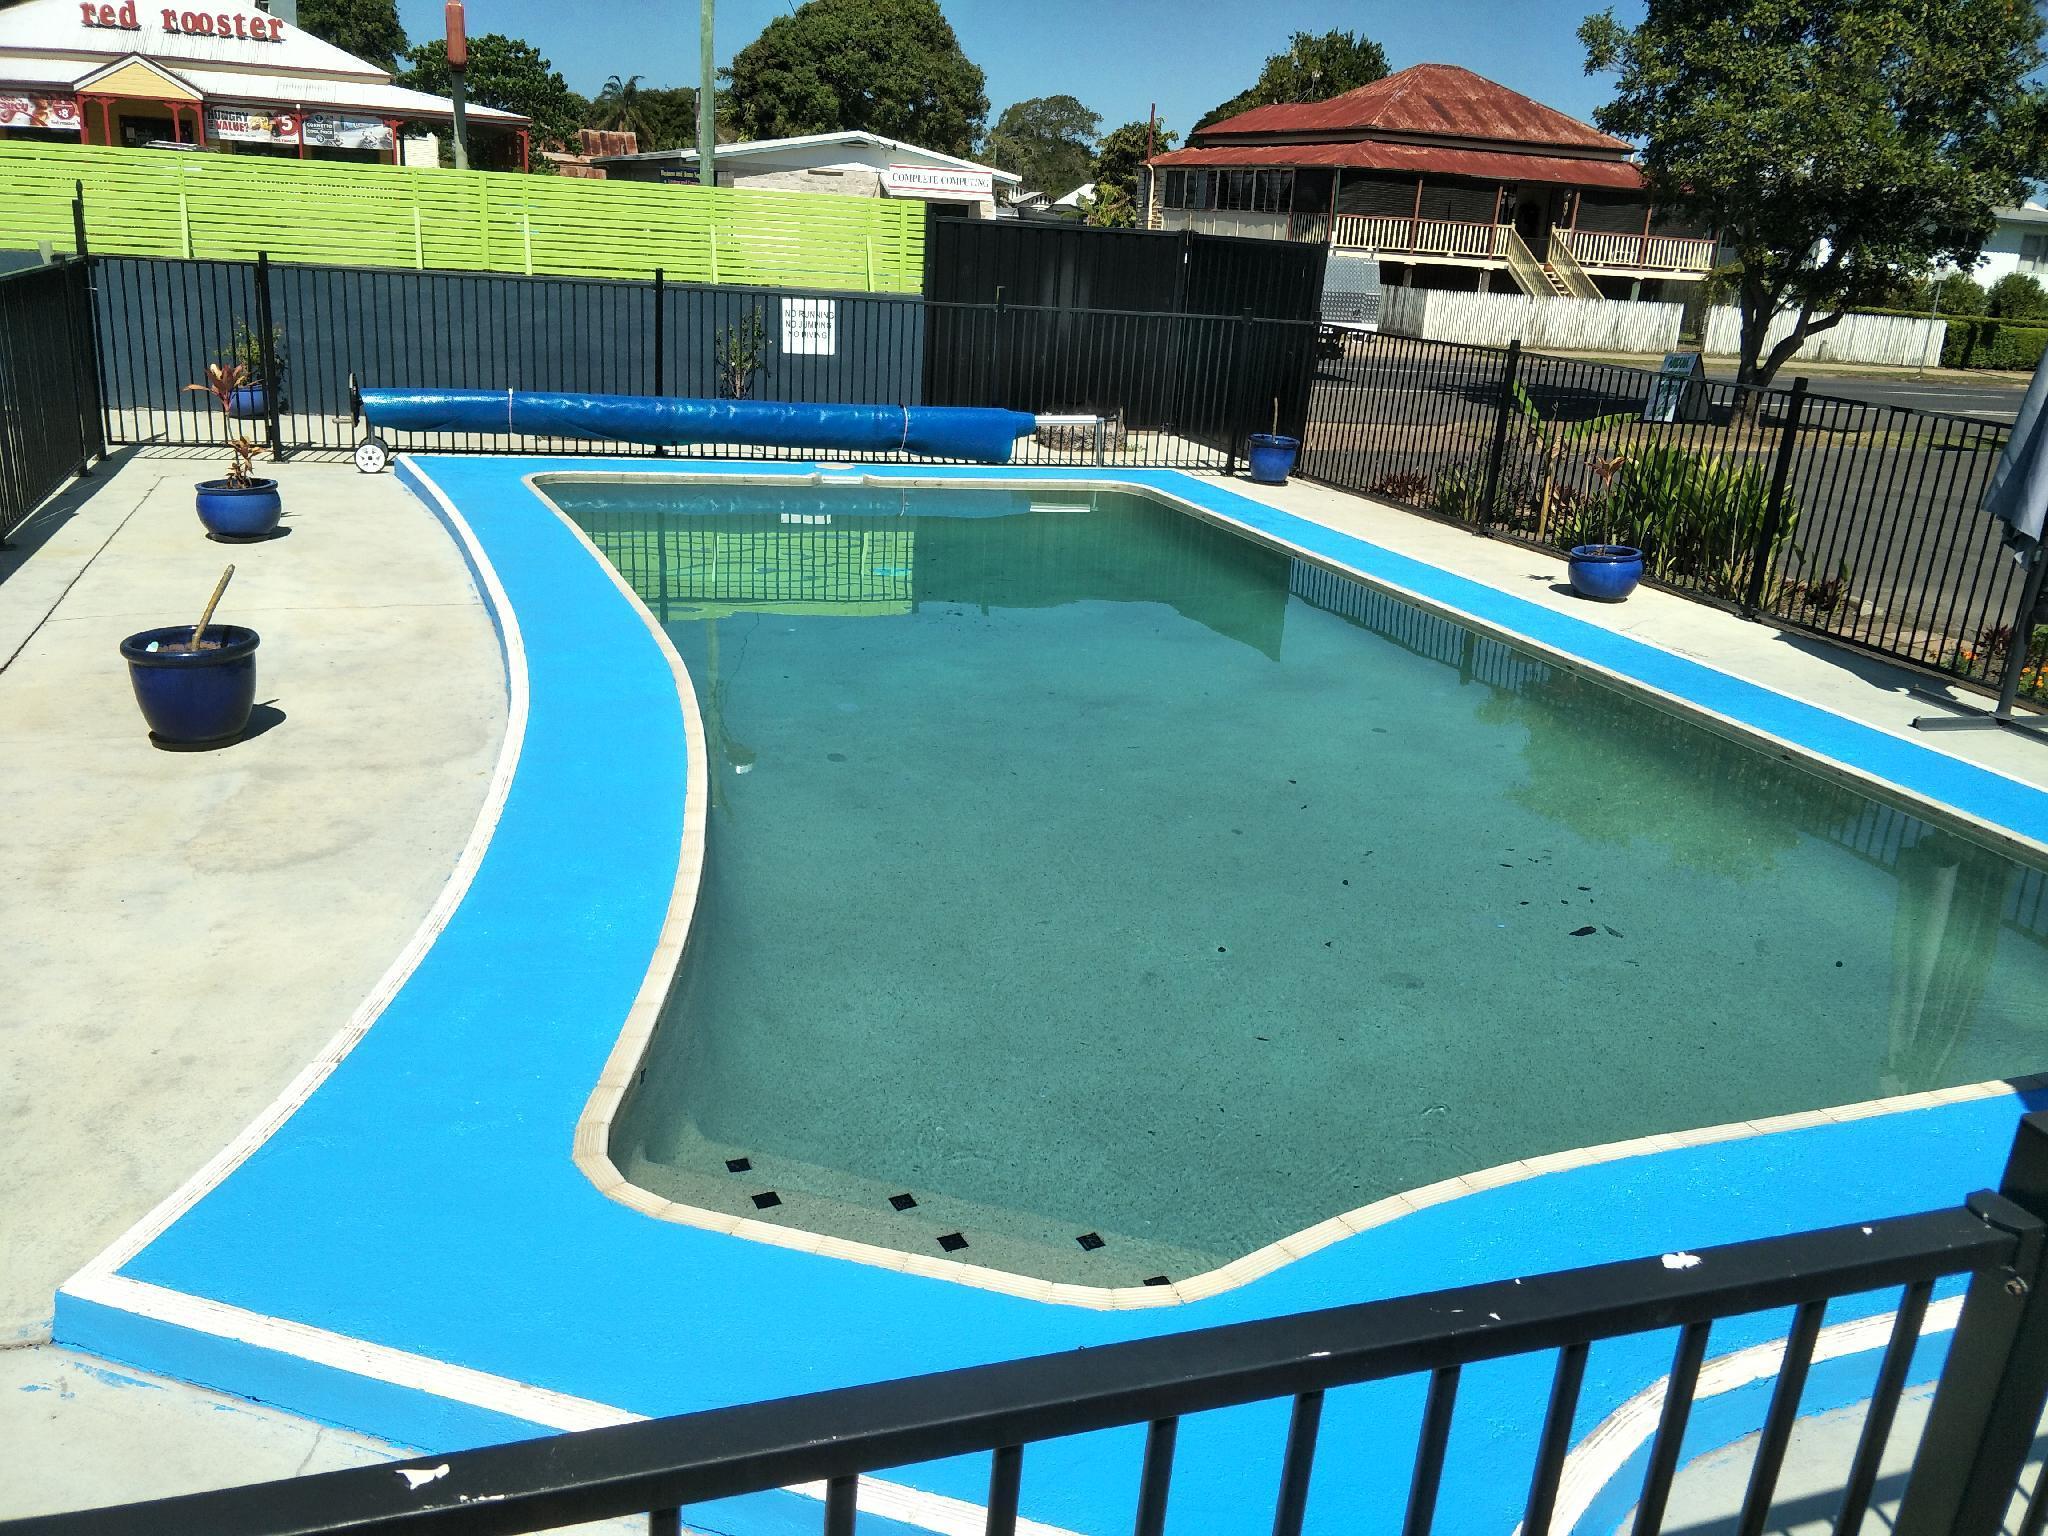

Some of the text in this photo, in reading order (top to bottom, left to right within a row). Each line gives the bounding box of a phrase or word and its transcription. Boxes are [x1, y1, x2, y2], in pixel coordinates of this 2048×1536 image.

[80, 0, 284, 39] red rooster
[208, 109, 249, 122] HUNGRY
[215, 120, 249, 132] VALUE?
[892, 172, 989, 188] COMPLETE COMPUTING
[785, 309, 797, 318] NO
[785, 320, 797, 329] NO
